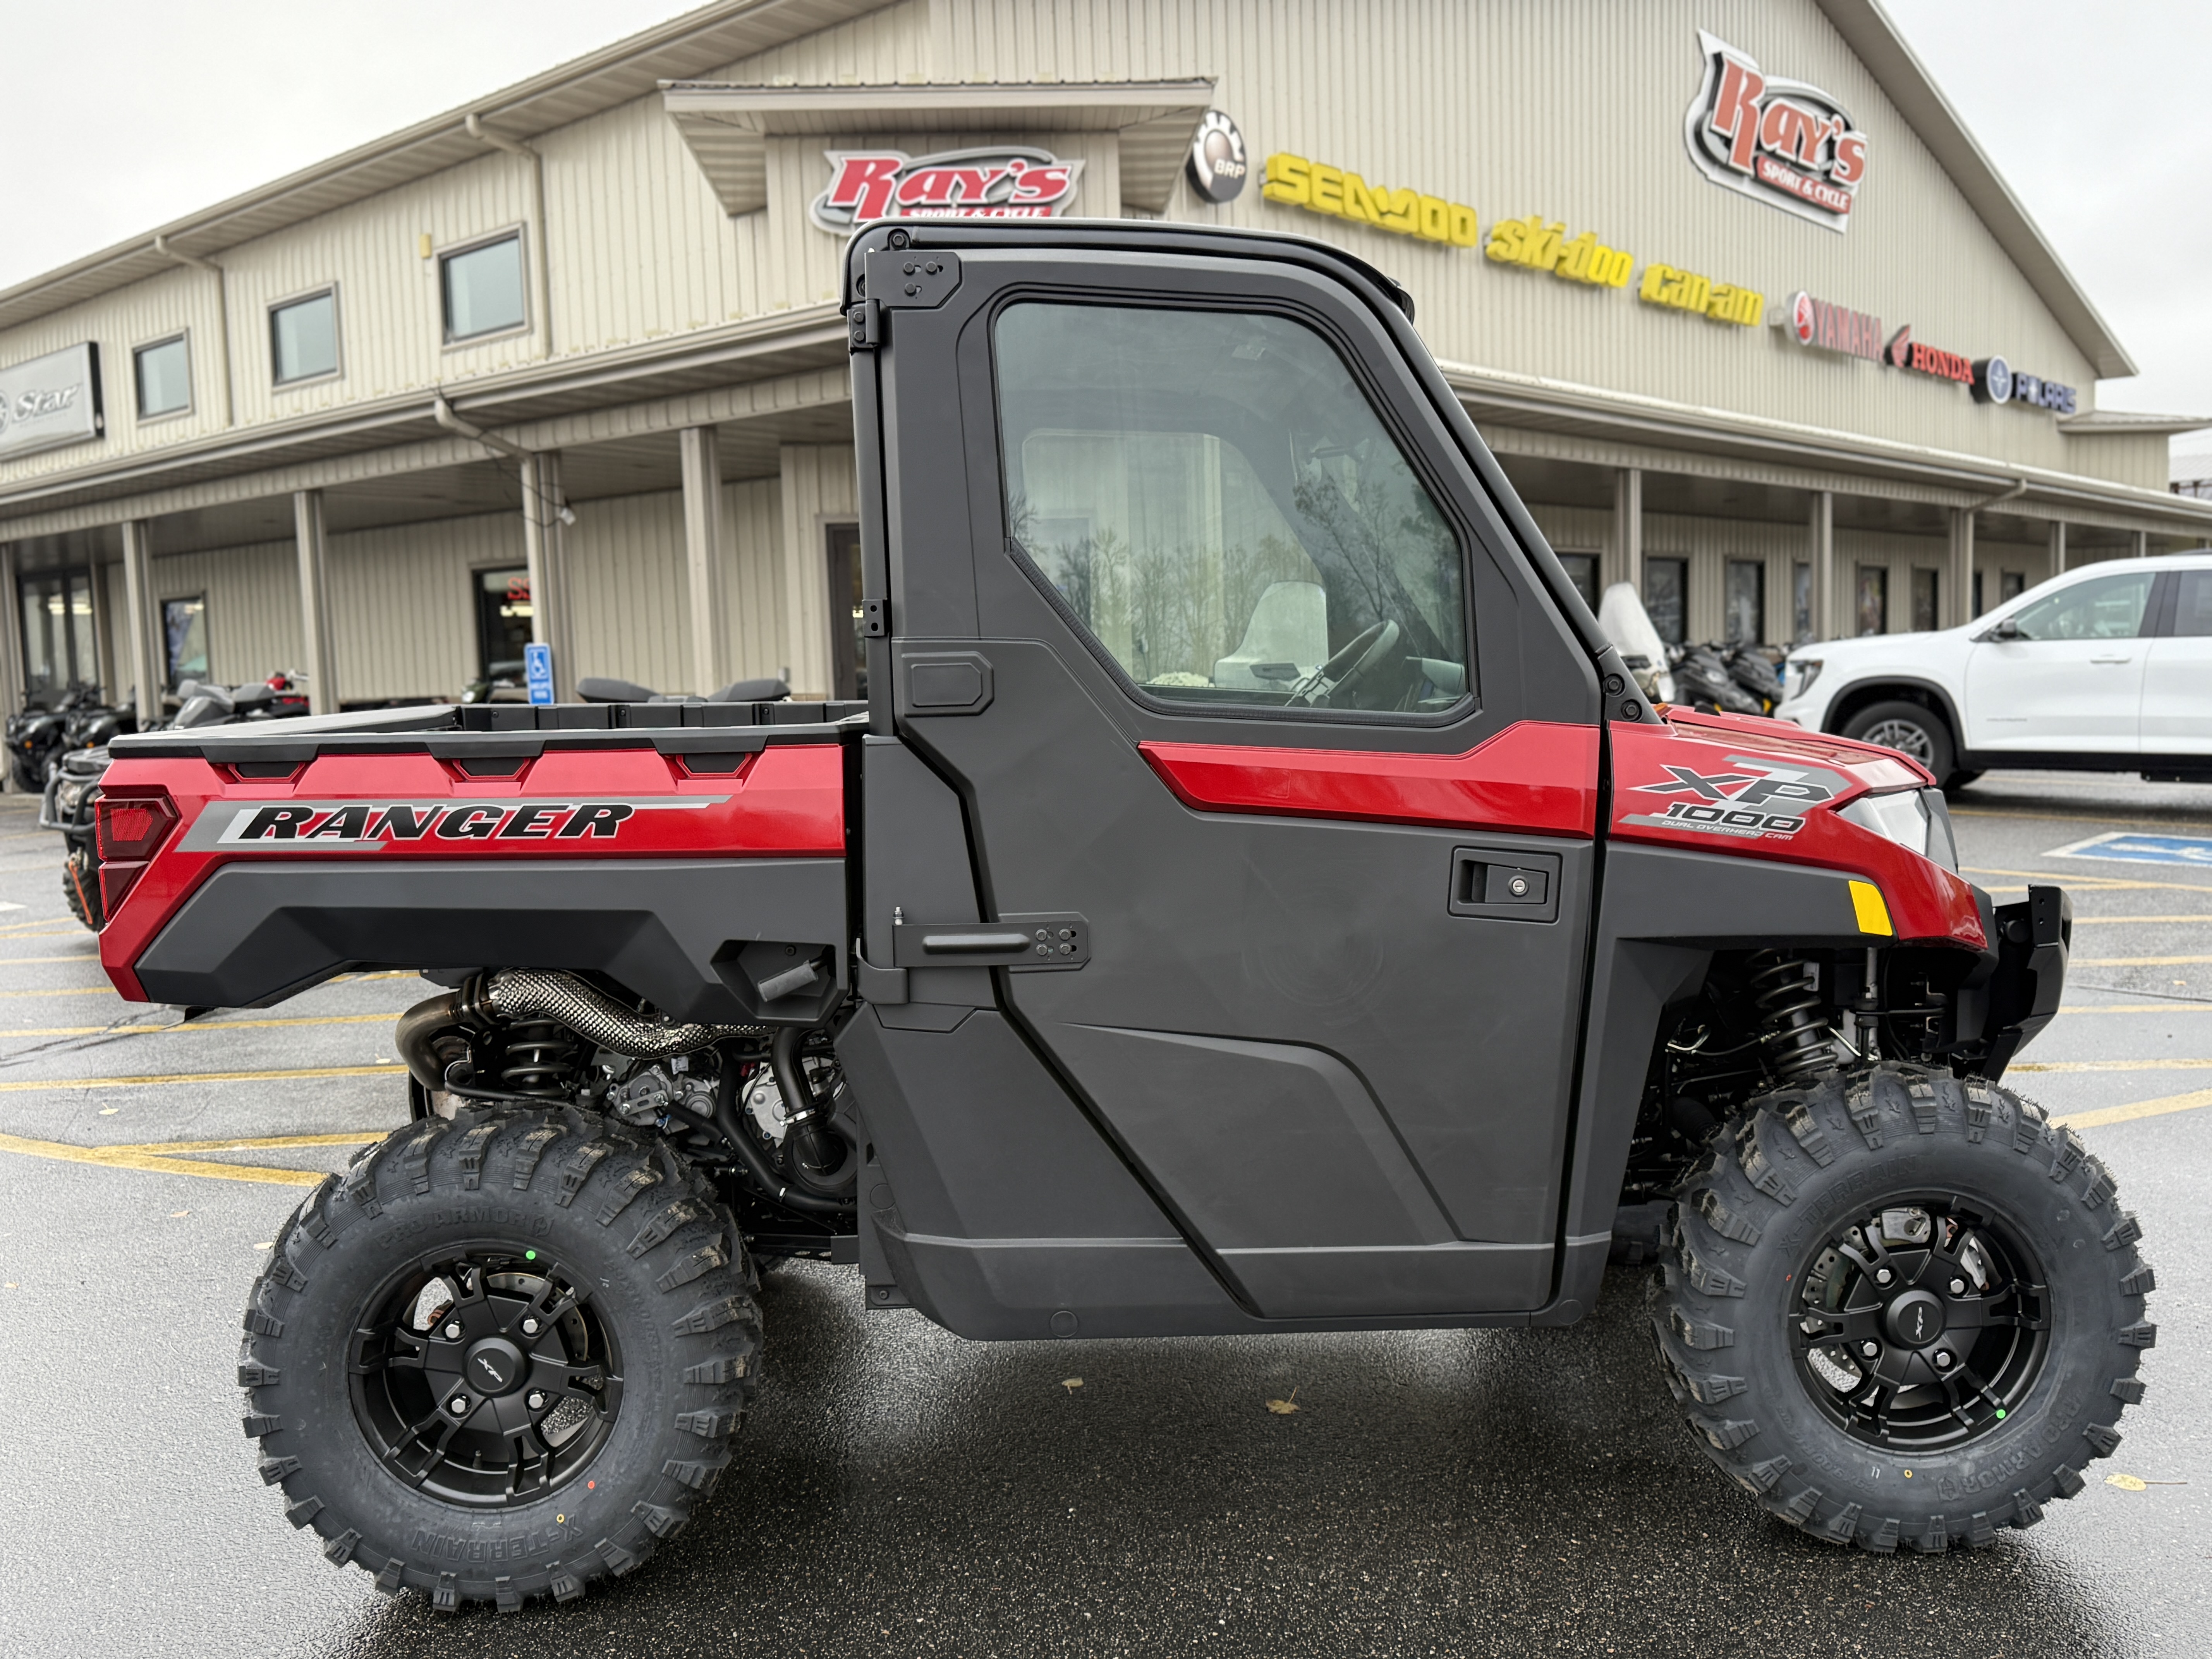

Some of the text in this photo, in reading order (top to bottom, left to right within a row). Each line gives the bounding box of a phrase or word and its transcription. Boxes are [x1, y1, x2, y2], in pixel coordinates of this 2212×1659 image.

[1214, 158, 1245, 179] BRP
[1762, 161, 1849, 210] SPORT & CYCLE
[1814, 298, 1884, 362] YAMAHA
[1912, 342, 1974, 385] HONDA
[12, 383, 82, 423] Star
[2016, 372, 2076, 414] POLARIS
[1626, 764, 1834, 807] XP
[238, 804, 634, 840] RANGER
[1662, 820, 1794, 841] DUAL OVERHEAD CAM
[1666, 802, 1806, 834] 1000
[376, 1205, 529, 1250] PRO ARMOR
[1776, 1157, 1917, 1256] X-TERRAIN
[1915, 1306, 1923, 1340] XP
[477, 1357, 503, 1382] XP
[1962, 1398, 2081, 1495] PRO ARMOR
[410, 1514, 584, 1563] X-TERRAIN
